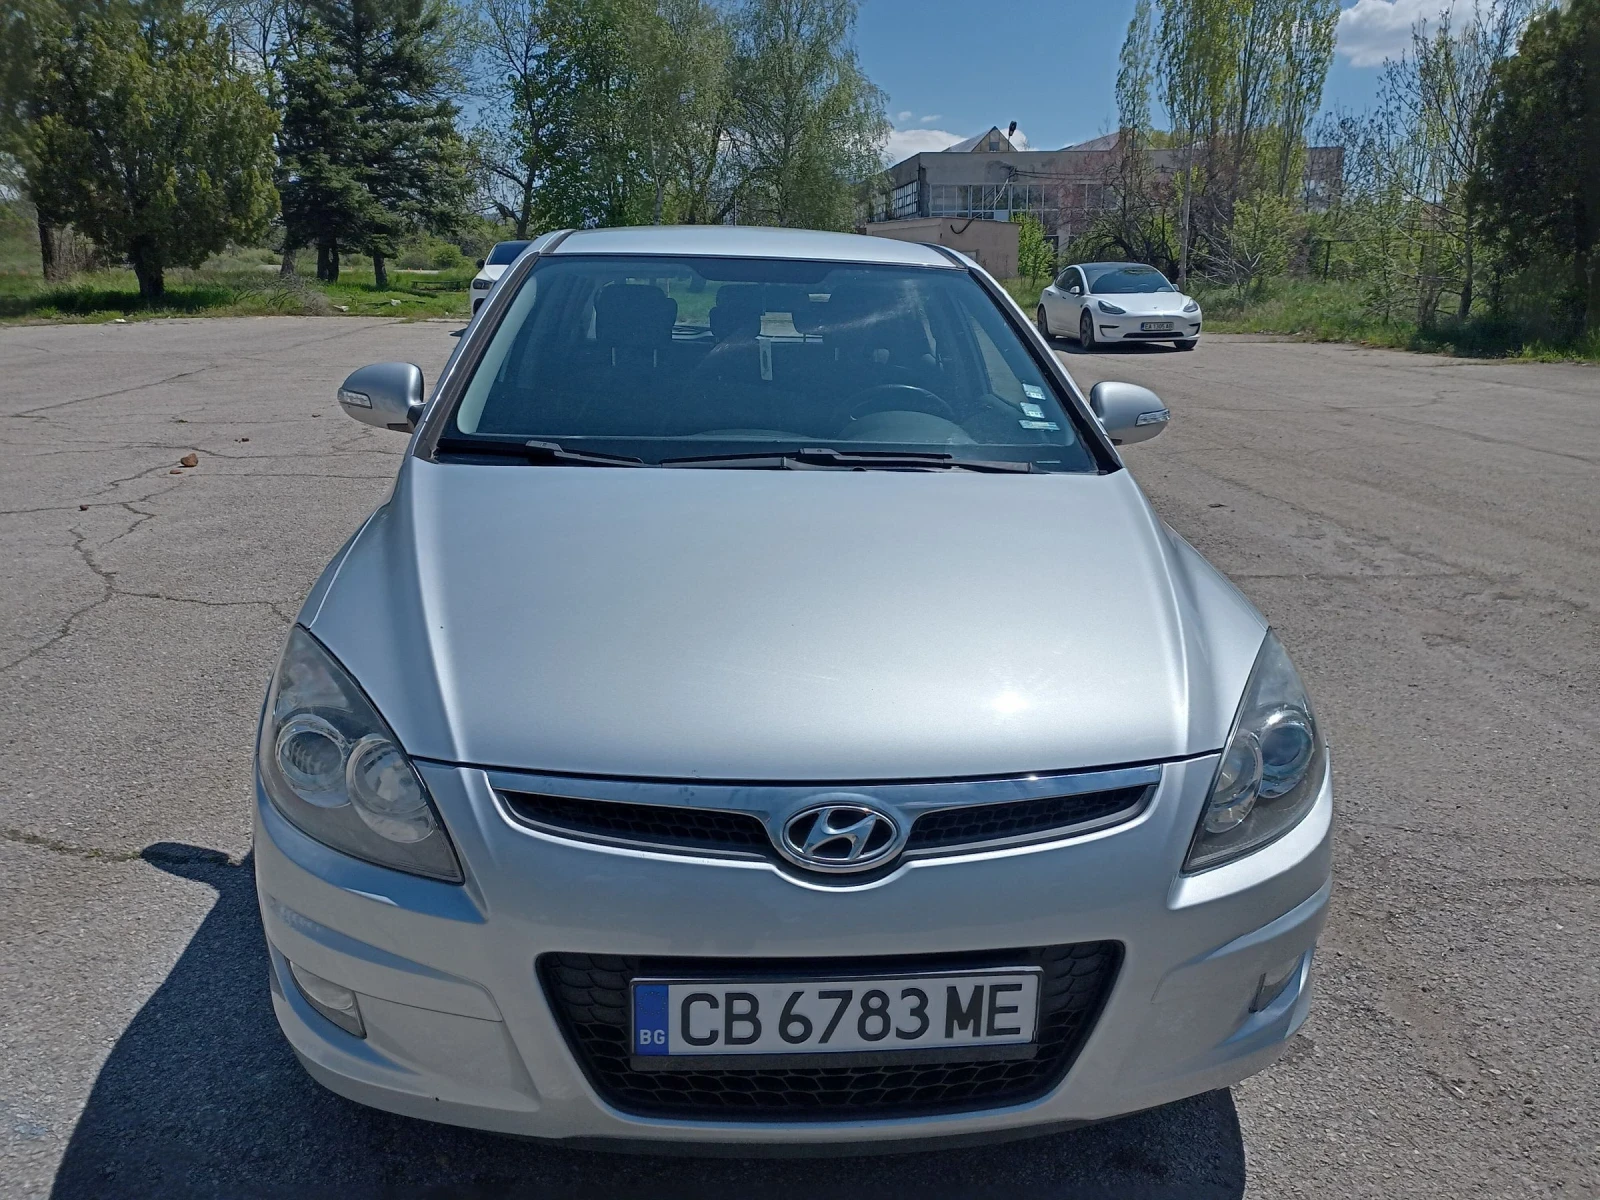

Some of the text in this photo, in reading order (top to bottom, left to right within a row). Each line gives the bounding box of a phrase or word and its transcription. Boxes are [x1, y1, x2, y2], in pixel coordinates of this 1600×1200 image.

[680, 983, 1023, 1046] CB 6783 ME
[639, 1029, 666, 1046] BG
